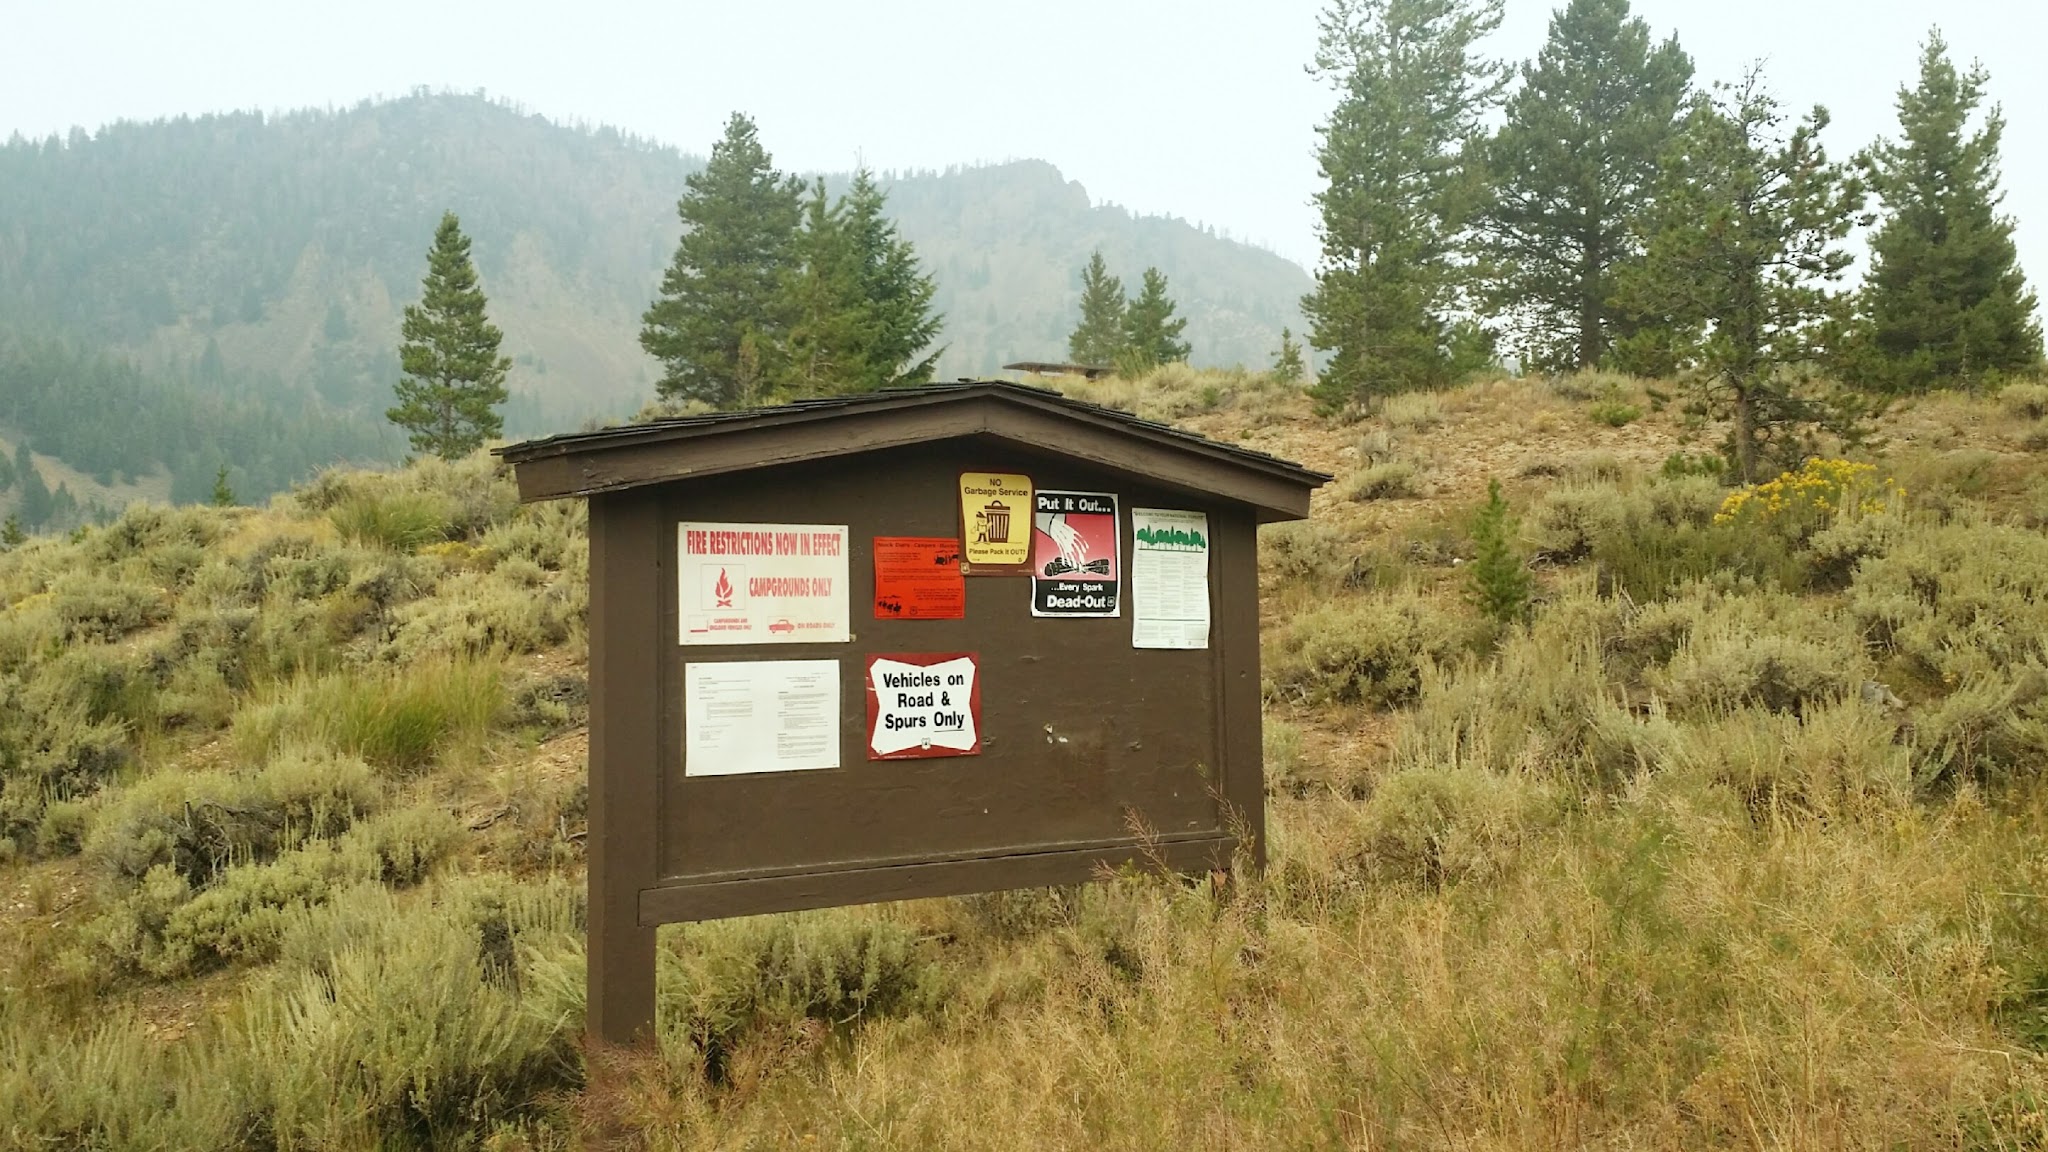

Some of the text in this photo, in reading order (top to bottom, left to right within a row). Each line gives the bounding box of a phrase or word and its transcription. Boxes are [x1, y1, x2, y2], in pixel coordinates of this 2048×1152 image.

[964, 487, 1028, 497] Garbage Service
[1038, 497, 1111, 512] Put It Out...
[687, 531, 841, 556] FIRE RESTRICTIONS NOW IN EFFECT
[750, 577, 832, 597] CAMPGROUNDS ONLY
[1051, 583, 1103, 592] ...Every Spark
[1047, 594, 1106, 608] Dead-Out
[883, 672, 964, 688] Vehicles on
[898, 691, 951, 708] Road &
[885, 711, 964, 731] Spurs Only
